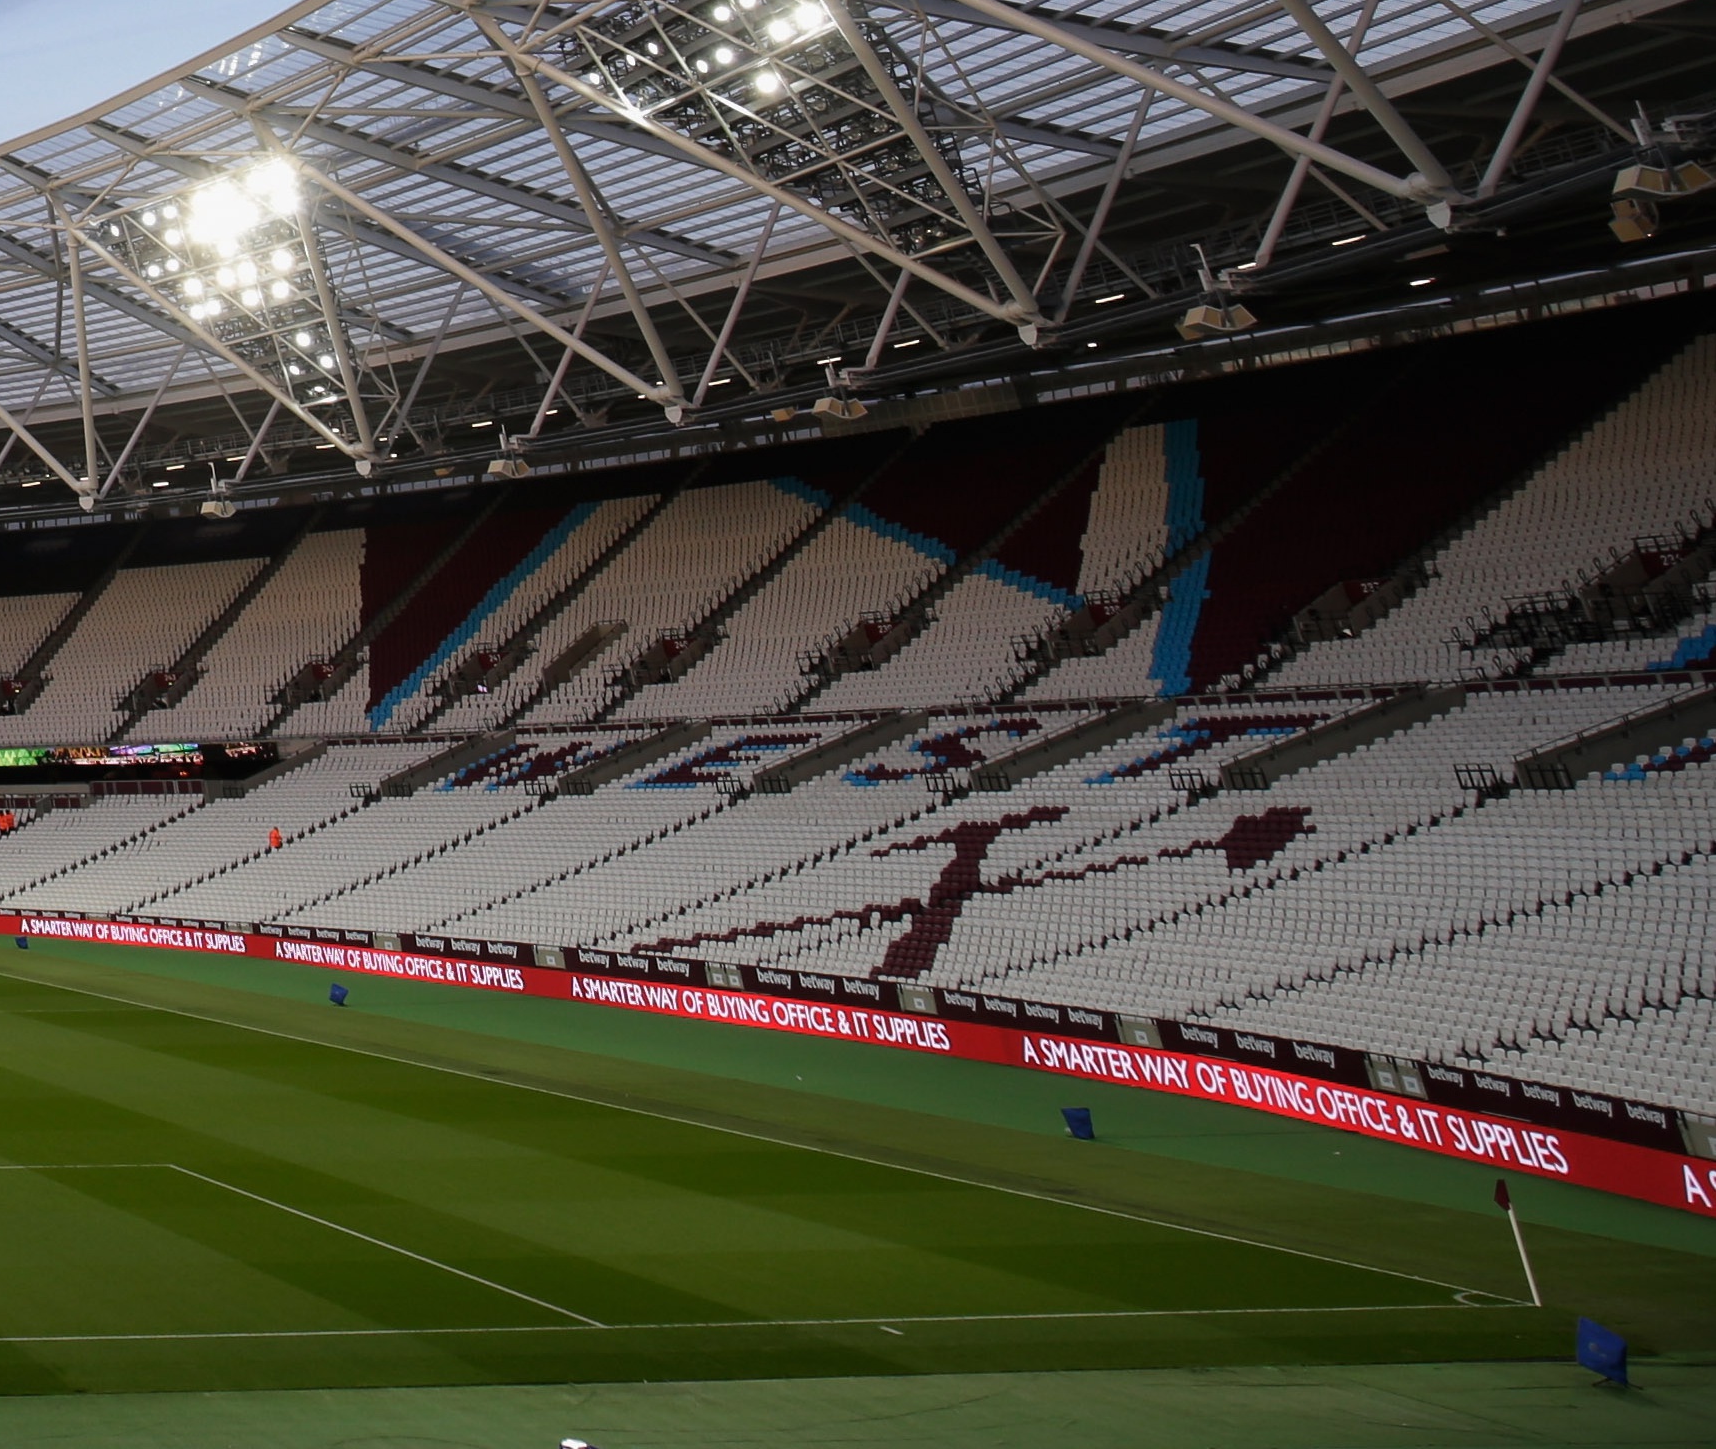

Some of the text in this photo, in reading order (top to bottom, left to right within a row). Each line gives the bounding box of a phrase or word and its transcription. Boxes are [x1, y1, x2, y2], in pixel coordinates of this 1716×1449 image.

[31, 919, 73, 937] SMARTER
[72, 923, 93, 938] WAY
[96, 924, 110, 939] OF
[110, 925, 148, 944] BUYING
[149, 928, 182, 946] OFFICE
[193, 932, 202, 948] IT
[206, 933, 246, 953] SUPPLIES
[415, 935, 445, 952] betway
[450, 938, 480, 955] betway
[487, 941, 518, 958] betway
[578, 950, 610, 969] betway
[283, 942, 323, 963] SMARTER
[323, 947, 345, 965] WAY
[348, 950, 362, 968] OF
[363, 952, 405, 974] BUYING
[406, 957, 443, 979] OFFICE
[456, 964, 467, 982] IT
[470, 965, 524, 990] SUPPLIES
[617, 953, 649, 973] betway
[655, 958, 690, 977] betway
[755, 968, 791, 990] betway
[798, 973, 835, 995] betway
[842, 978, 880, 1000] betway
[943, 990, 977, 1012] betway
[982, 996, 1017, 1018] betway
[584, 978, 645, 1006] SMARTER
[644, 986, 678, 1010] WAY
[682, 990, 704, 1014] OF
[706, 993, 769, 1023] BUYING
[772, 1001, 836, 1033] OFFICE
[852, 1012, 869, 1038] IT
[872, 1014, 950, 1050] SUPPLIES
[1023, 1002, 1059, 1024] betway
[1067, 1007, 1103, 1030] betway
[1179, 1023, 1218, 1049] betway
[1234, 1031, 1275, 1058] betway
[1292, 1041, 1335, 1069] betway
[1426, 1065, 1464, 1088] betway
[1473, 1073, 1511, 1097] betway
[1521, 1081, 1560, 1107] betway
[1572, 1091, 1613, 1118] betway
[1040, 1039, 1138, 1081] SMARTER
[1136, 1055, 1191, 1089] WAY
[1195, 1063, 1227, 1095] OF
[1228, 1068, 1314, 1115] BUYING
[1316, 1091, 1397, 1135] OFFICE
[1416, 1109, 1444, 1146] IT
[1446, 1114, 1569, 1175] SUPPLIES
[1623, 1101, 1667, 1129] betway
[1683, 1164, 1712, 1208] A
